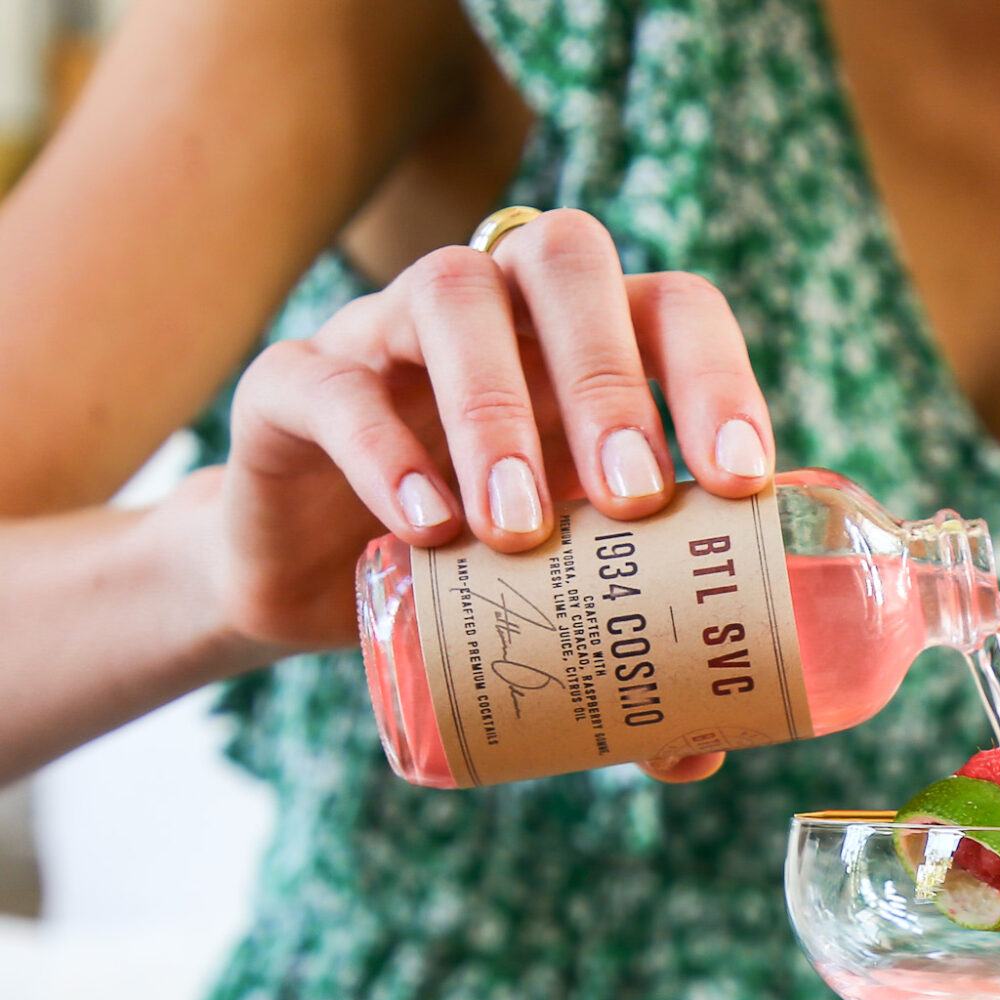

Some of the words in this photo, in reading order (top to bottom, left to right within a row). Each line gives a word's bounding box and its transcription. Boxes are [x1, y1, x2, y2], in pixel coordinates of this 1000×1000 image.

[549, 556, 565, 589] FRESH
[562, 548, 577, 585] VODKA,
[594, 531, 642, 602] 1934
[688, 535, 738, 605] BTL
[456, 557, 478, 637] HAND-CRAFTED
[553, 591, 568, 619] LIME
[567, 588, 581, 609] DRY
[558, 625, 574, 663] JUICE,
[571, 612, 591, 670] CURACAO,
[583, 594, 601, 646] CRAFTED
[592, 650, 607, 677] WITH
[702, 622, 755, 697] SVC
[467, 641, 487, 691] PREMIUM
[565, 666, 583, 707] CITRUS
[606, 613, 665, 728] COSMO
[476, 693, 499, 746] COCKTAILS
[573, 709, 587, 722] OIL
[581, 674, 604, 731] RASPBERRY
